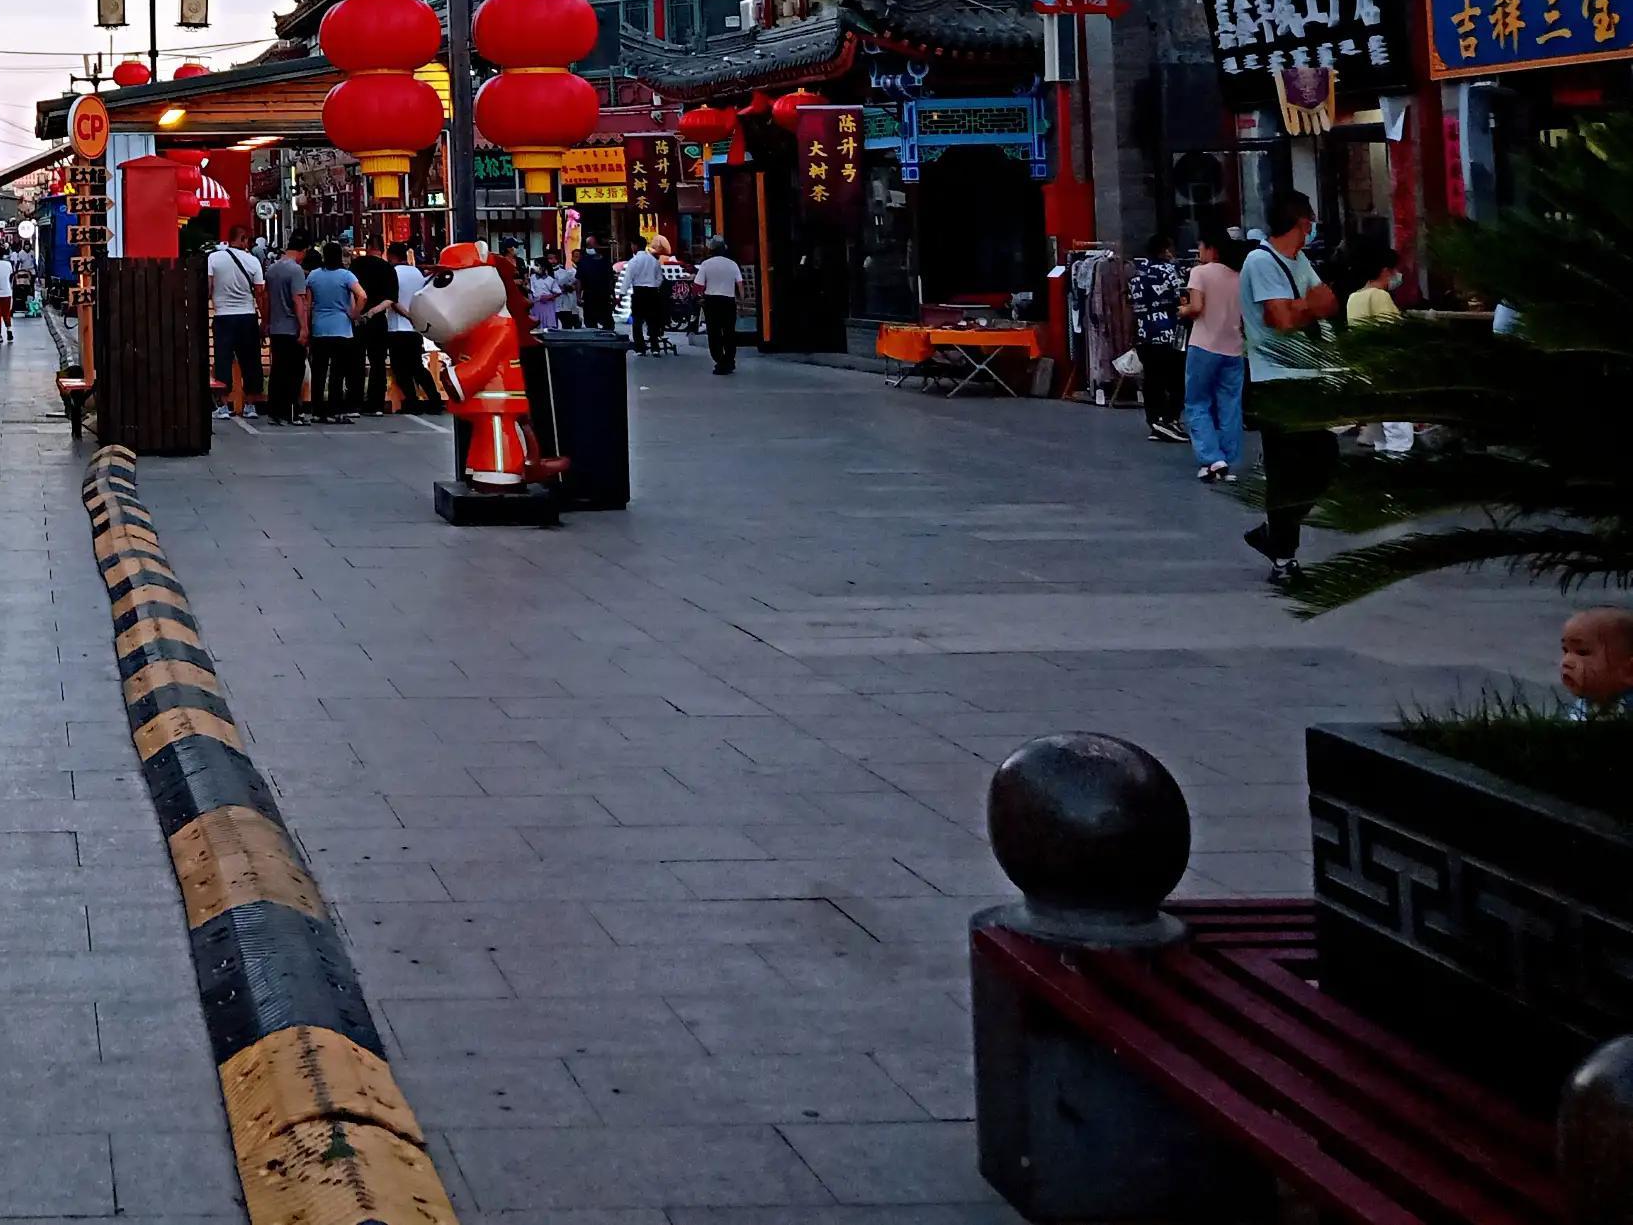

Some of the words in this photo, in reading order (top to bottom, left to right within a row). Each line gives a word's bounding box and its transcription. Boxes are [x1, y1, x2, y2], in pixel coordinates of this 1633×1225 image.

[76, 112, 104, 141] CP
[836, 113, 858, 184] 陈升号
[632, 160, 651, 210] 大树茶
[654, 140, 672, 194] 陈升号
[808, 140, 830, 203] 大树茶
